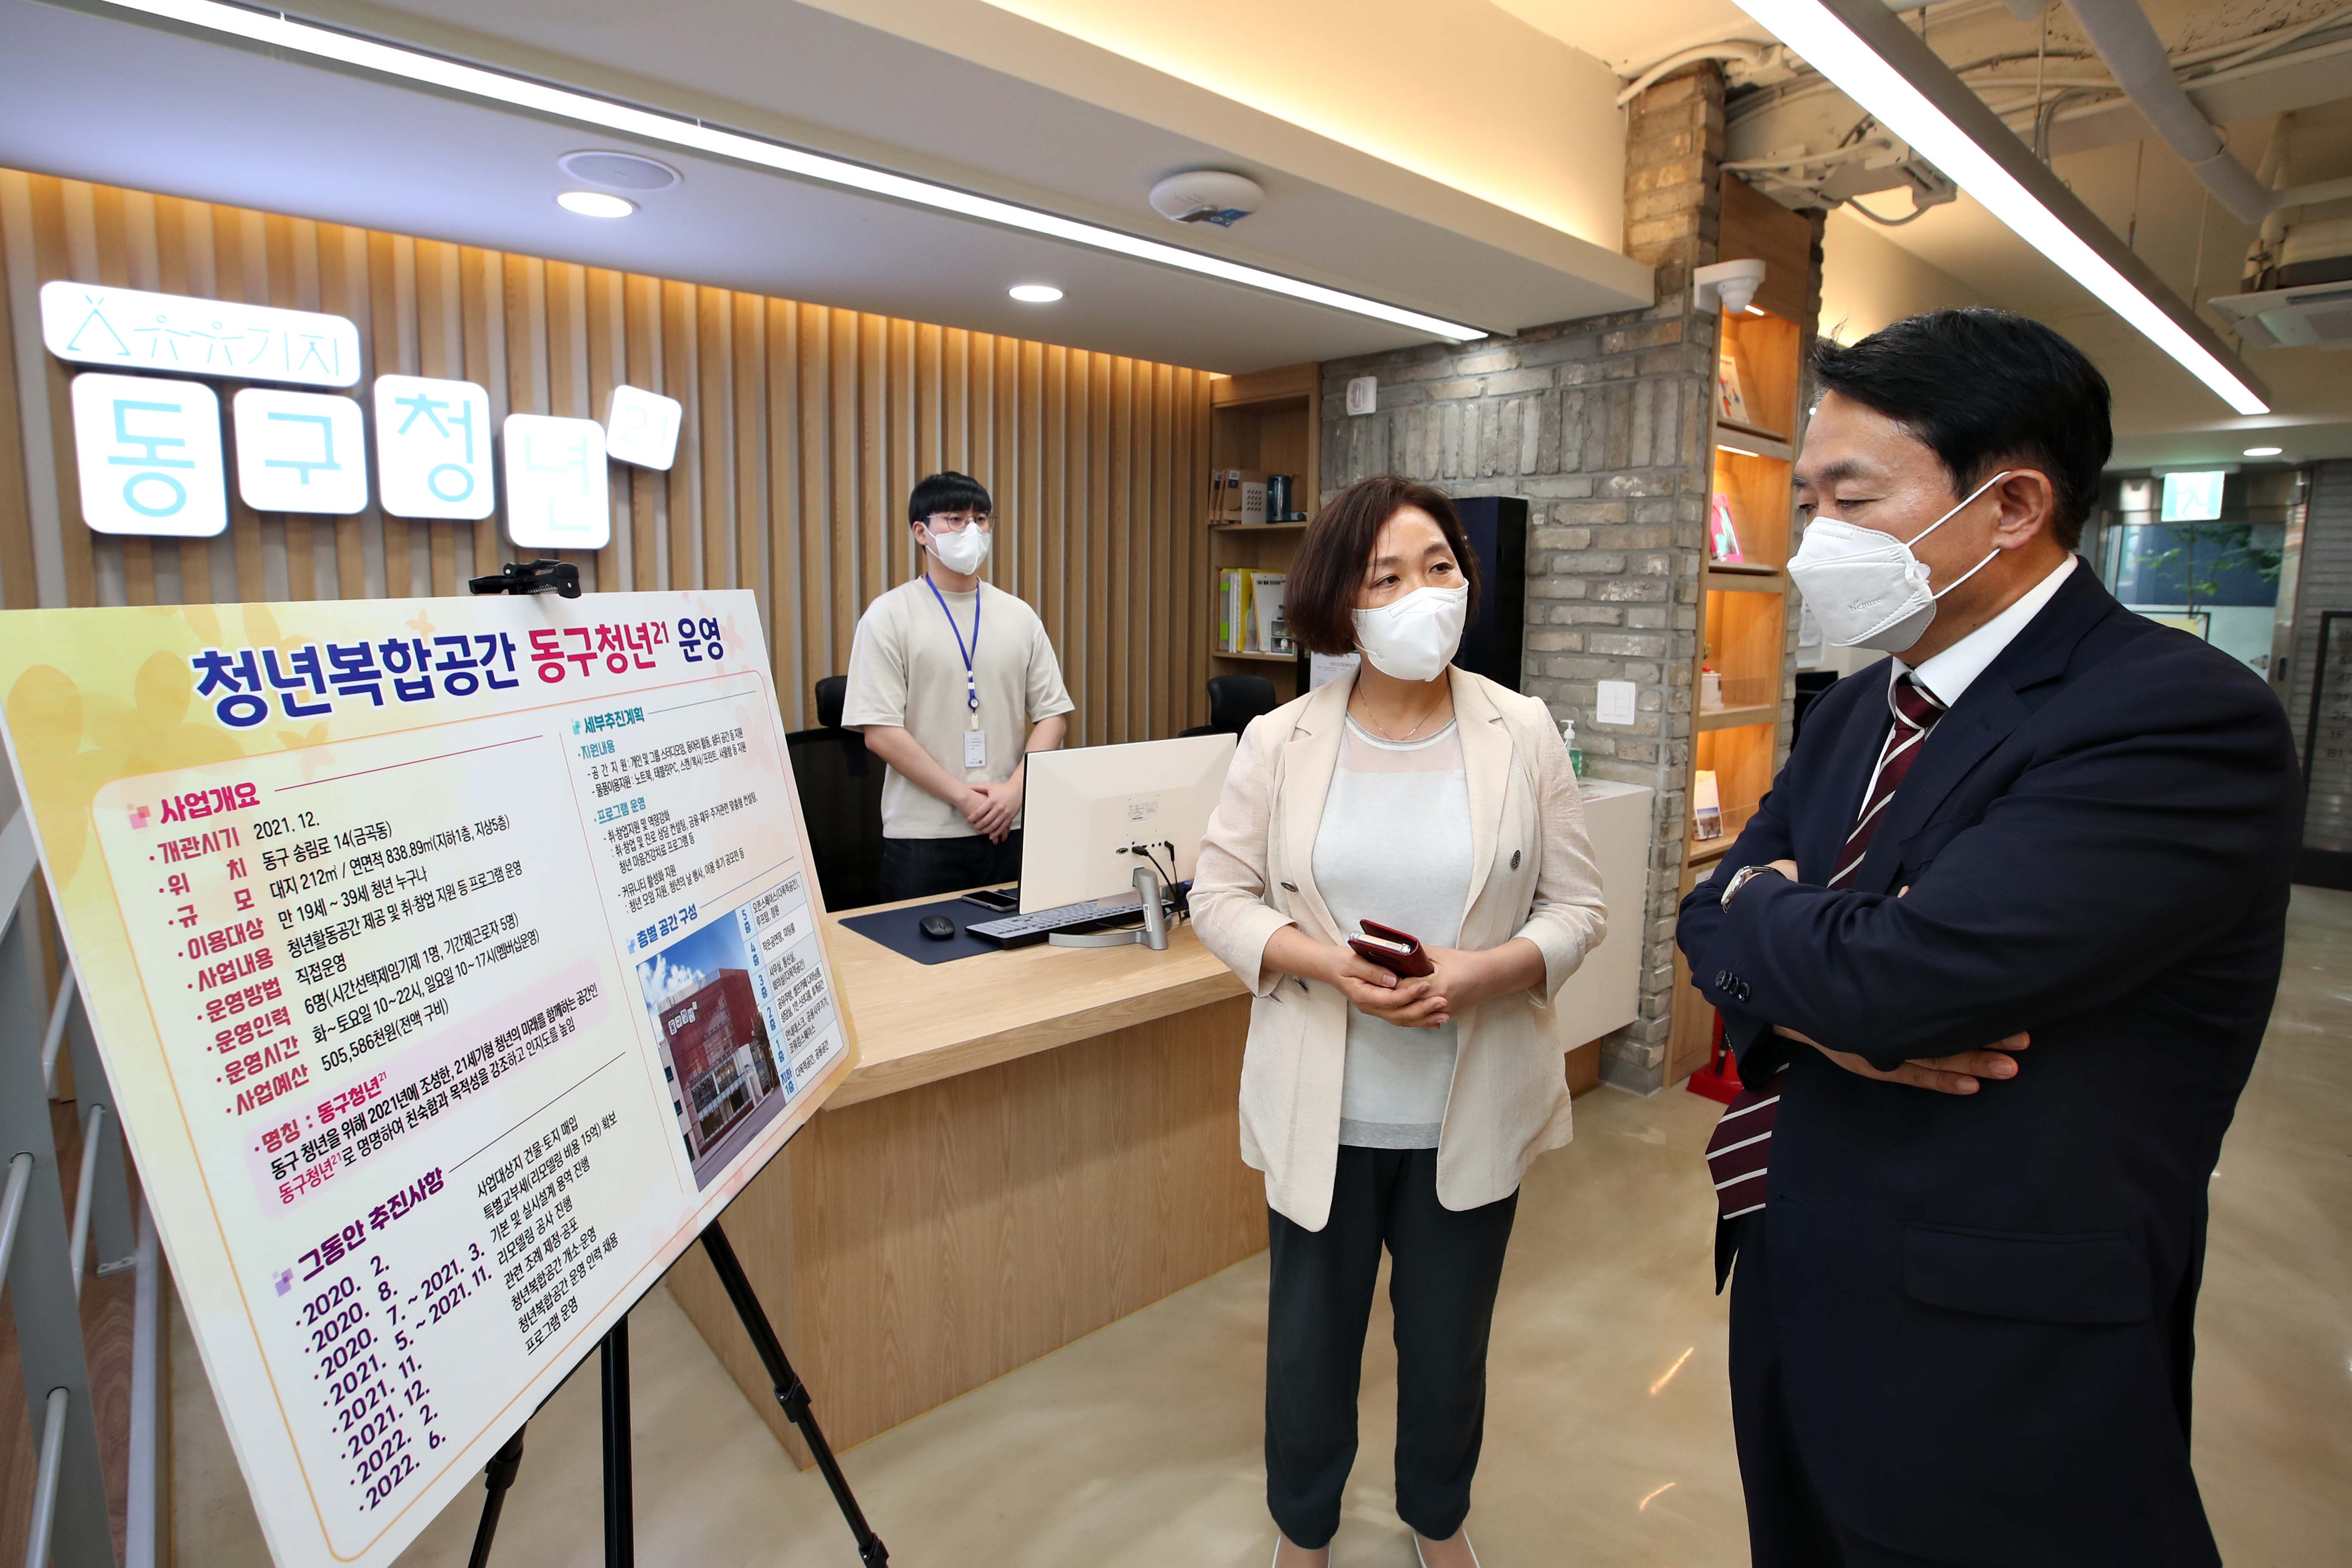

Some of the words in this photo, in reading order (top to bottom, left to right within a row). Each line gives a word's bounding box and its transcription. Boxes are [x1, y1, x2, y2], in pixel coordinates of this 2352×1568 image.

[193, 633, 519, 726] 청년복합공간
[677, 617, 724, 663] 운영
[584, 706, 645, 734] 세부추진계획
[580, 739, 616, 760] 지원내용
[157, 827, 240, 864] 개관시기
[253, 817, 295, 840] 2021.
[297, 811, 320, 829] 12.
[160, 782, 260, 824] 사업개요
[262, 848, 290, 871] 동구
[293, 837, 332, 863] 송림로
[333, 820, 392, 849] 14(금곡동)
[597, 802, 630, 824] 프로그램
[630, 796, 646, 813] 운영
[619, 857, 633, 874] 청년
[632, 843, 668, 867] 마음건강치료
[666, 834, 689, 853] 프로그램
[643, 830, 658, 846] 진로
[669, 818, 689, 836] 컨설팅,
[647, 809, 671, 828] 역량강화
[269, 876, 299, 899] 대지
[349, 850, 385, 876] 연면적
[474, 814, 510, 837] 지상5층)
[621, 877, 647, 898] 커뮤니티
[646, 869, 665, 889] 활성화
[664, 864, 677, 879] 지원
[628, 895, 643, 913] 청년
[642, 889, 655, 906] 모임
[654, 884, 670, 899] 지원,
[668, 875, 686, 894] 청년의
[692, 867, 705, 882] 행사,
[704, 861, 716, 875] 이용
[715, 856, 726, 871] 후기
[725, 849, 740, 866] 공모전
[187, 917, 264, 960] 이용대상
[297, 897, 328, 922] 19세
[340, 884, 370, 907] 39세
[370, 876, 395, 899] 청년
[395, 865, 428, 890] 누구나
[199, 947, 274, 992] 사업내용
[287, 917, 361, 959] 청년활동공간
[361, 908, 386, 930] 제공
[386, 903, 401, 923] 및
[435, 883, 457, 902] 지원
[469, 866, 505, 891] 프로그램
[505, 859, 522, 879] 운영
[637, 924, 659, 949] 층별
[658, 913, 679, 937] 공간
[678, 903, 698, 925] 구성
[205, 976, 282, 1023] 운영방법
[295, 952, 347, 986] 직접운영
[215, 1006, 291, 1055] 운영인력
[422, 944, 444, 964] 1명,
[444, 919, 499, 954] 기간제근로자
[499, 912, 519, 931] 5명)
[225, 1035, 300, 1085] 운영시간
[424, 966, 455, 994] 일요일
[236, 1063, 310, 1116] 사업예산
[423, 997, 449, 1022] 구비)
[270, 1150, 300, 1180] 동구
[300, 1128, 342, 1163] 청년을
[341, 1112, 368, 1140] 위해
[368, 1082, 420, 1124] 2021년에
[419, 1065, 455, 1096] 조성한,
[454, 1040, 495, 1075] 21세기형
[494, 1026, 522, 1053] 청년의
[521, 1012, 547, 1035] 미래를
[545, 997, 577, 1024] 함께하는
[576, 982, 599, 1006] 공간인
[356, 1116, 405, 1157] 명명하여
[405, 1090, 449, 1129] 친숙함과
[449, 1067, 490, 1100] 목적성을
[489, 1046, 527, 1078] 강조하고
[525, 1026, 559, 1057] 인지도를
[558, 1016, 576, 1038] 높임
[261, 1118, 301, 1154] 명칭
[297, 1219, 367, 1282] 그동안
[368, 1167, 444, 1231] 추진사항
[303, 1276, 361, 1327] 2020.
[370, 1255, 390, 1277] 2.
[477, 1154, 524, 1198] 사업대상지
[560, 1115, 579, 1136] 매입
[311, 1302, 370, 1354] 2020.
[377, 1280, 398, 1302] 8.
[483, 1150, 564, 1220] 특별교부세(리모델링
[563, 1139, 580, 1159] 비용
[580, 1122, 601, 1146] 15억)
[601, 1110, 618, 1130] 확보
[321, 1328, 378, 1380] 2020.
[386, 1304, 406, 1326] 7.
[420, 1258, 465, 1301] 2021.
[468, 1243, 485, 1262] 3.
[490, 1218, 511, 1243] 기본
[510, 1209, 523, 1229] 및
[522, 1182, 557, 1220] 실시설계
[556, 1168, 574, 1192] 용역
[573, 1155, 590, 1179] 진행
[329, 1353, 387, 1407] 2021.
[394, 1329, 414, 1351] 5.
[429, 1281, 472, 1325] 2021.
[472, 1265, 492, 1287] 11.
[496, 1225, 535, 1265] 리모델링
[535, 1210, 554, 1235] 공사
[554, 1194, 573, 1220] 진행
[338, 1378, 395, 1433] 2021.
[398, 1354, 422, 1379] 11.
[503, 1262, 525, 1290] 관련
[524, 1246, 544, 1273] 조례
[347, 1404, 404, 1459] 2021.
[404, 1379, 430, 1407] 12.
[511, 1256, 563, 1311] 청년복합공간
[356, 1429, 412, 1485] 2022.
[419, 1404, 438, 1427] 2.
[518, 1277, 570, 1333] 청년복합공간
[569, 1260, 587, 1287] 운영
[586, 1245, 603, 1271] 인력
[602, 1232, 618, 1254] 채용
[365, 1454, 420, 1511] 2022.
[429, 1430, 446, 1450] 6.
[525, 1312, 561, 1356] 프로그램
[560, 1295, 578, 1322] 운영
